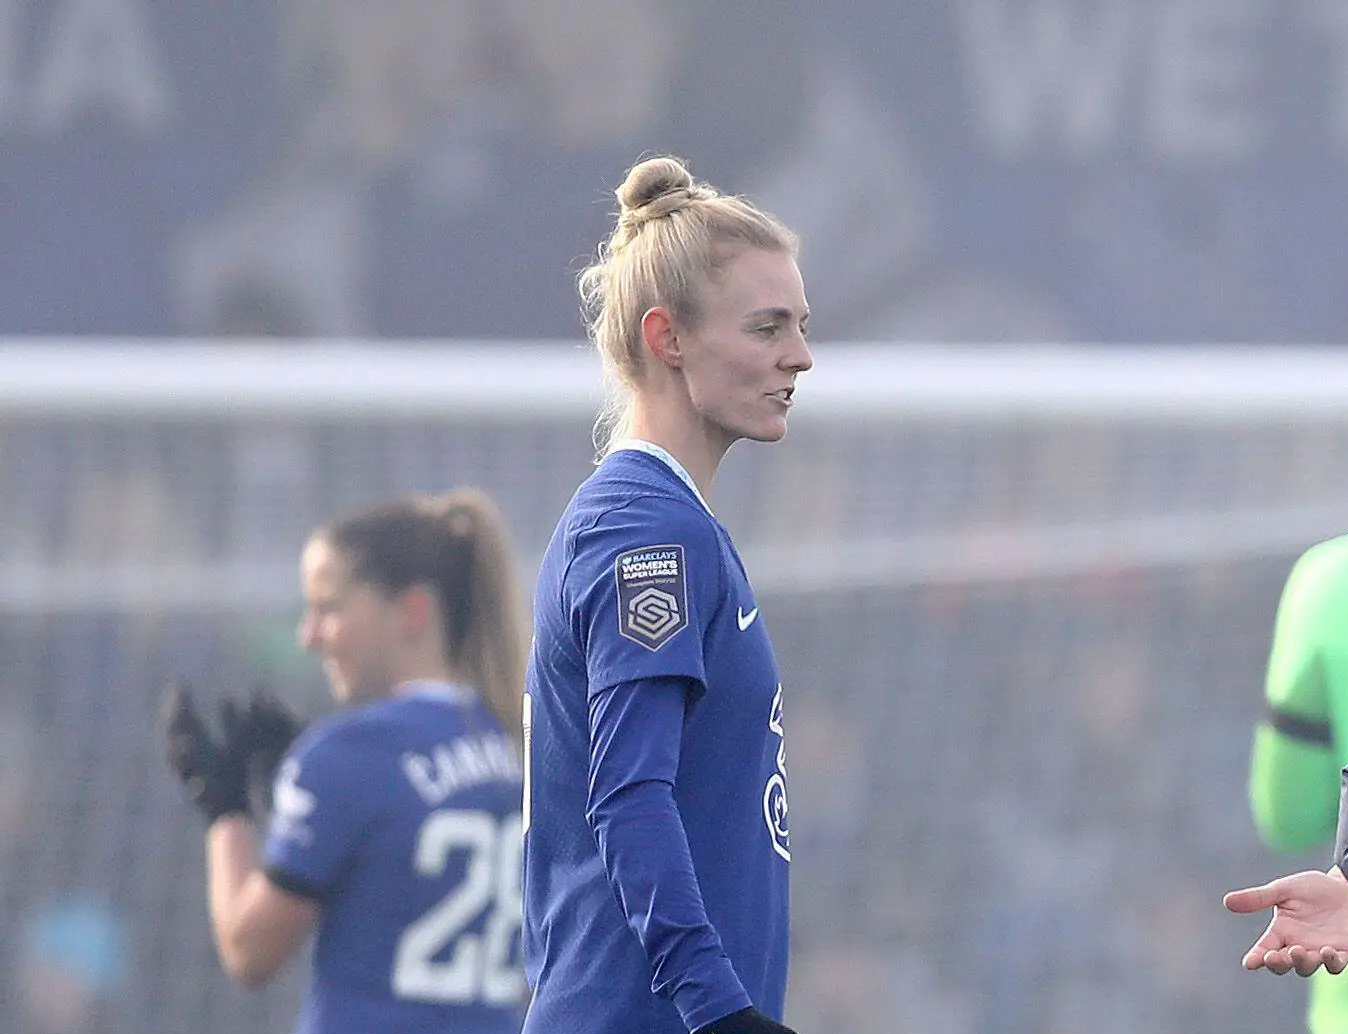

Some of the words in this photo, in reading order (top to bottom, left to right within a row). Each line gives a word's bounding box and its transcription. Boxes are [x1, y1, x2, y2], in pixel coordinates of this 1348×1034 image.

[963, 0, 1260, 162] WE
[633, 551, 677, 562] BARCLAYS
[622, 560, 678, 573] WOMEN'S
[623, 571, 647, 579] SUPER
